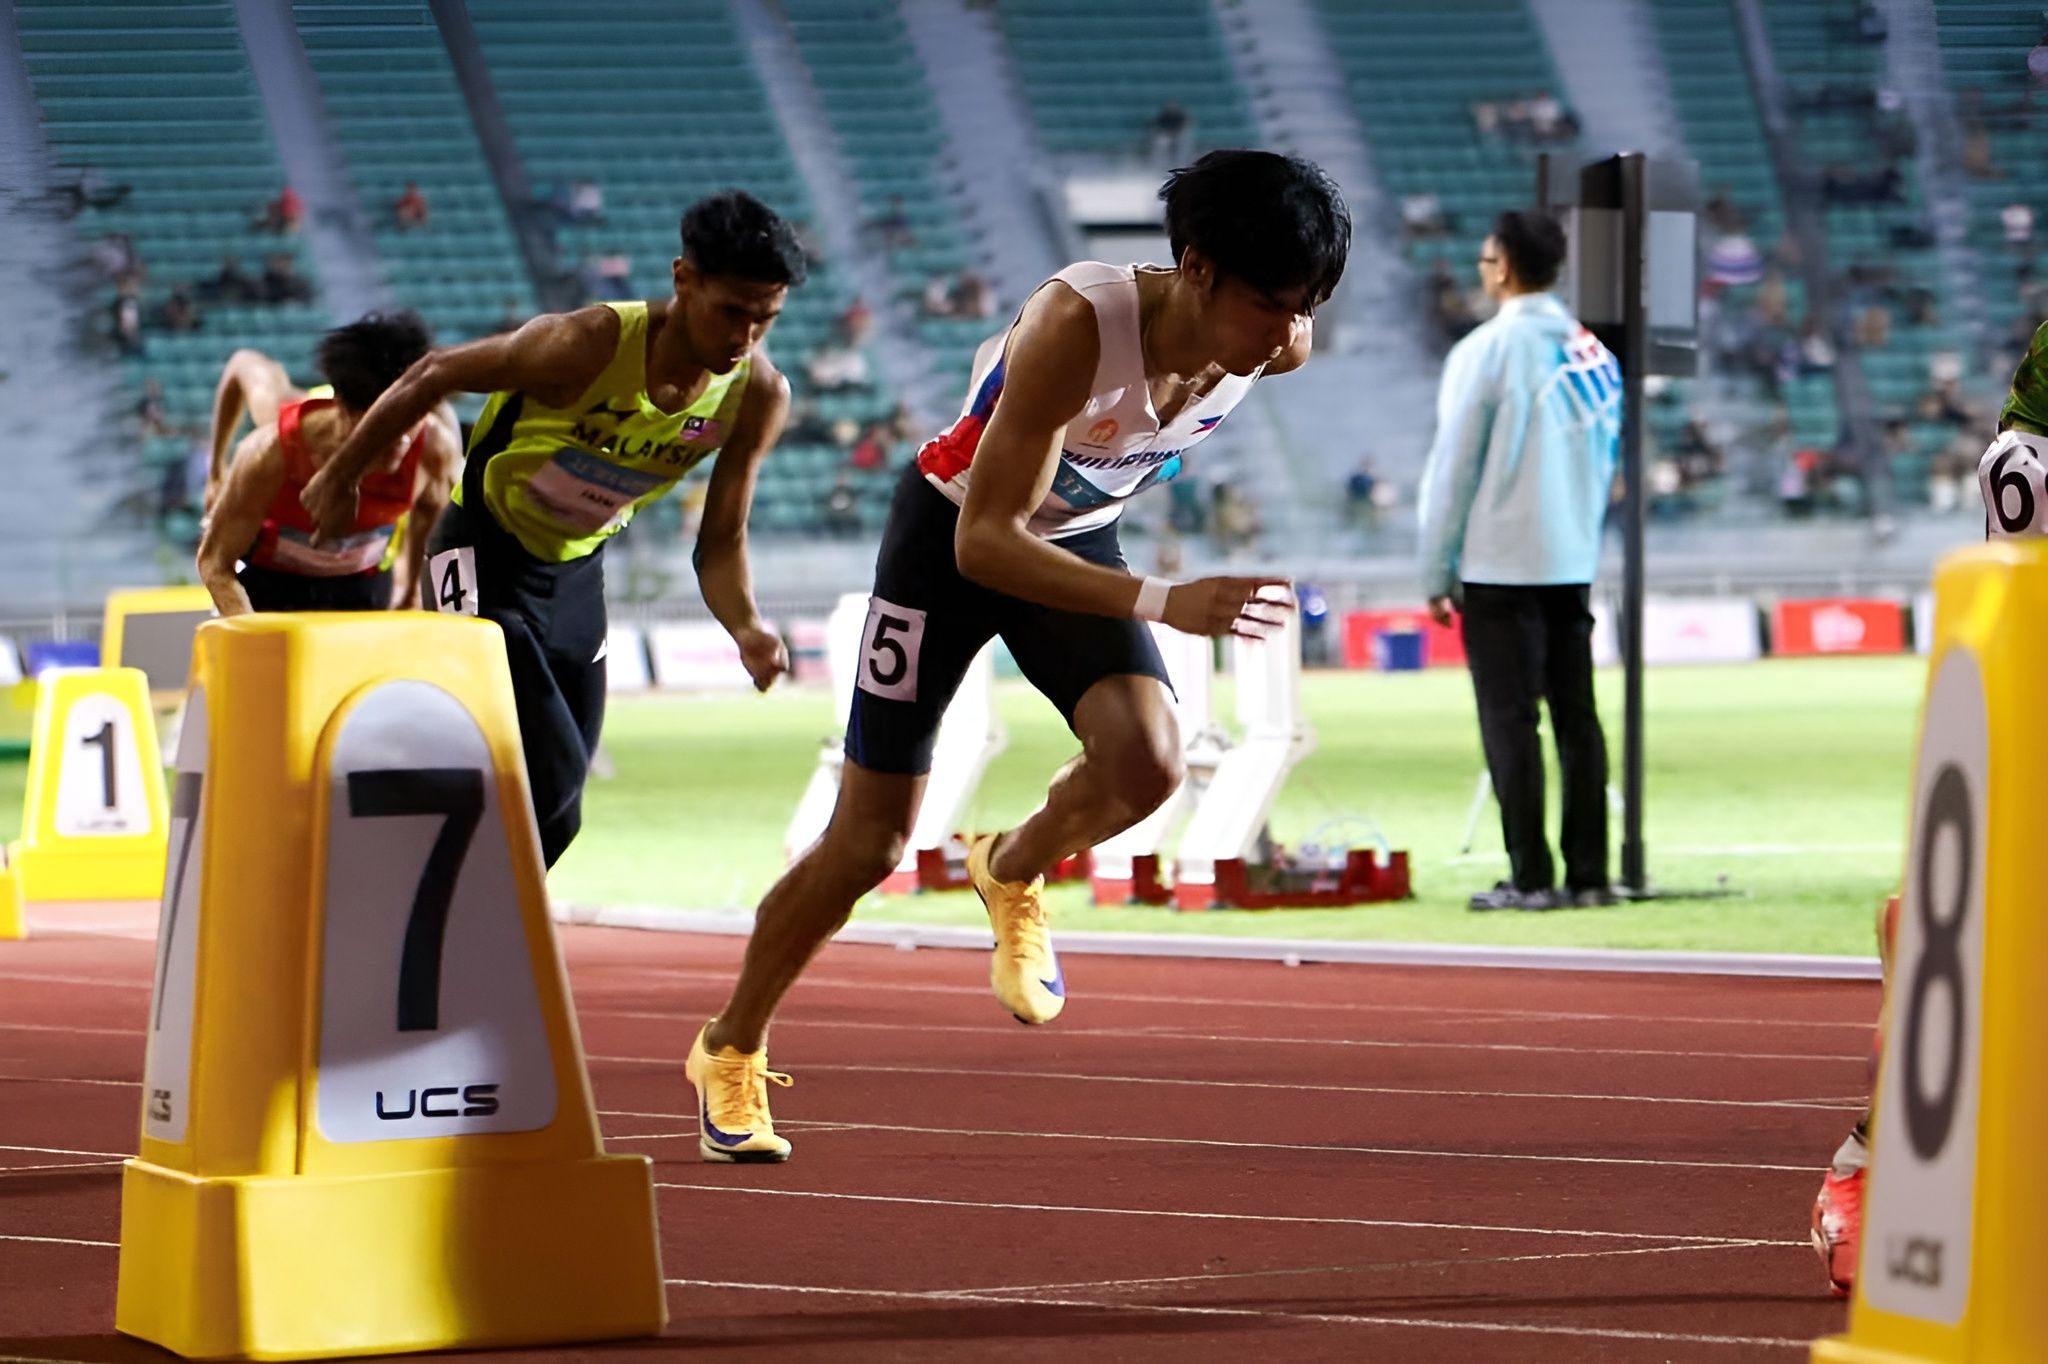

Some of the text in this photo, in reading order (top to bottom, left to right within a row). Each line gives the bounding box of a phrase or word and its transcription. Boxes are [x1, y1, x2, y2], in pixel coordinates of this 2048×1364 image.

[570, 419, 697, 467] MALAYSI
[441, 558, 467, 612] 4
[869, 612, 910, 686] 5
[82, 721, 115, 808] 1
[347, 768, 485, 1032] 7
[1905, 763, 1973, 1162] 8
[375, 1084, 500, 1120] UCS
